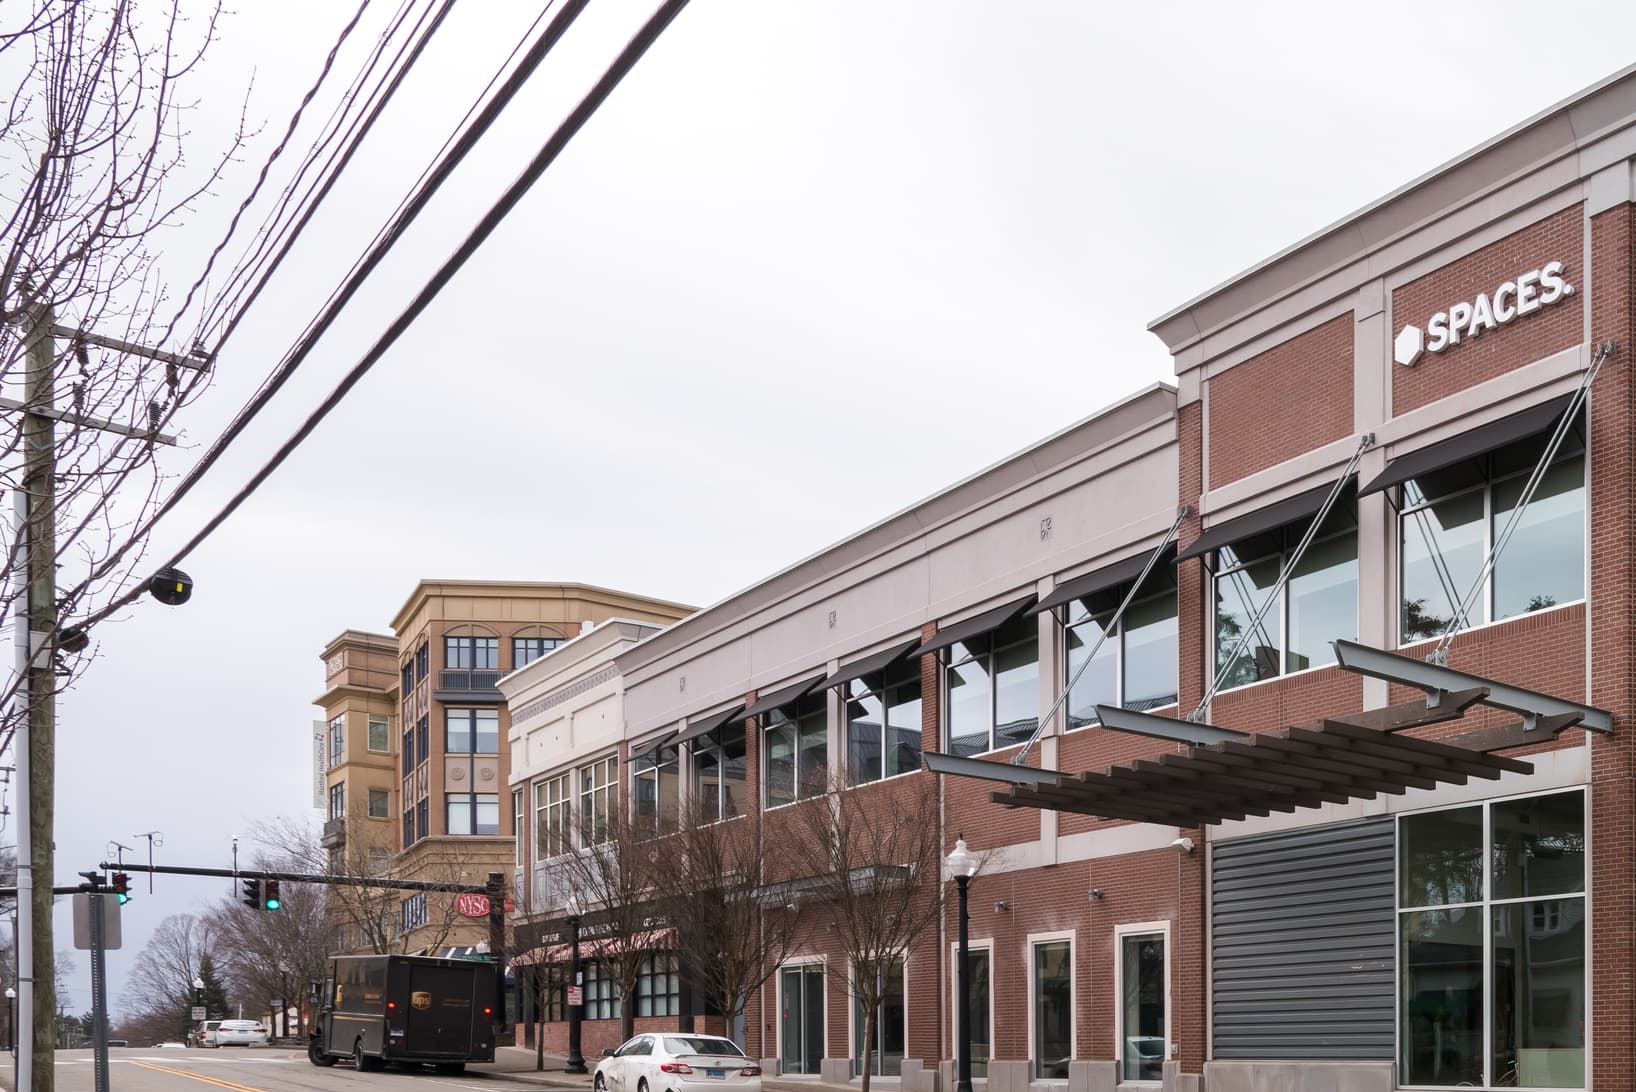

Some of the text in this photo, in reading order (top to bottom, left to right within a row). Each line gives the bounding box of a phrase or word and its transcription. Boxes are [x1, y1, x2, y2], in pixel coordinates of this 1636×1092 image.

[1427, 261, 1575, 353] SPACES.
[460, 896, 490, 915] NYSC
[414, 997, 431, 1007] ups
